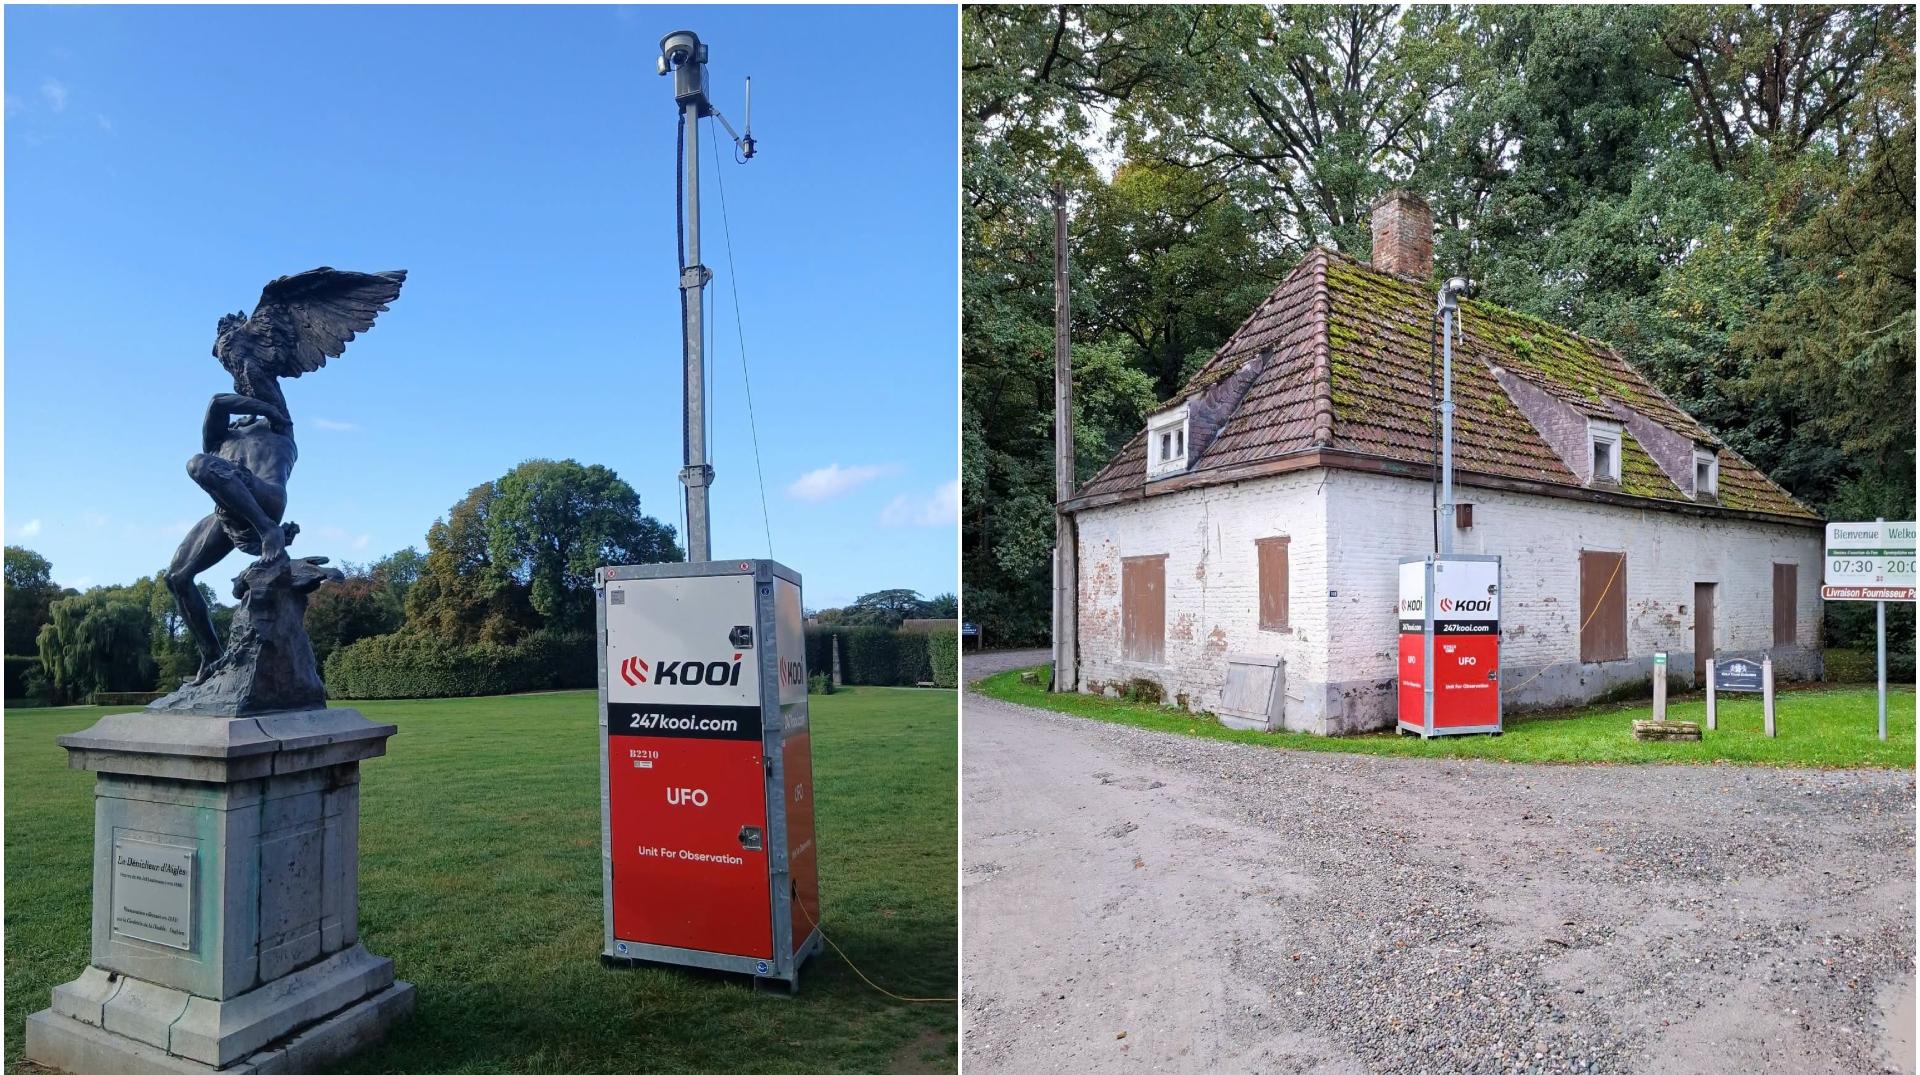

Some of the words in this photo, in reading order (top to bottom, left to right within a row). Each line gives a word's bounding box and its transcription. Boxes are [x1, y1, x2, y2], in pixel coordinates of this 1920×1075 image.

[1833, 528, 1879, 539] Bienvenue
[1833, 560, 1873, 573] 07:30
[1826, 587, 1860, 598] Livraison
[1861, 587, 1907, 599] Fournisseur
[1443, 624, 1490, 632] 247kooi.com
[1458, 656, 1477, 666] UFO
[629, 713, 738, 732] 247kooi.com
[629, 749, 659, 760] B2210
[666, 787, 709, 807] UFO
[638, 846, 658, 857] Unit
[660, 848, 677, 859] For
[678, 850, 743, 865] Observation
